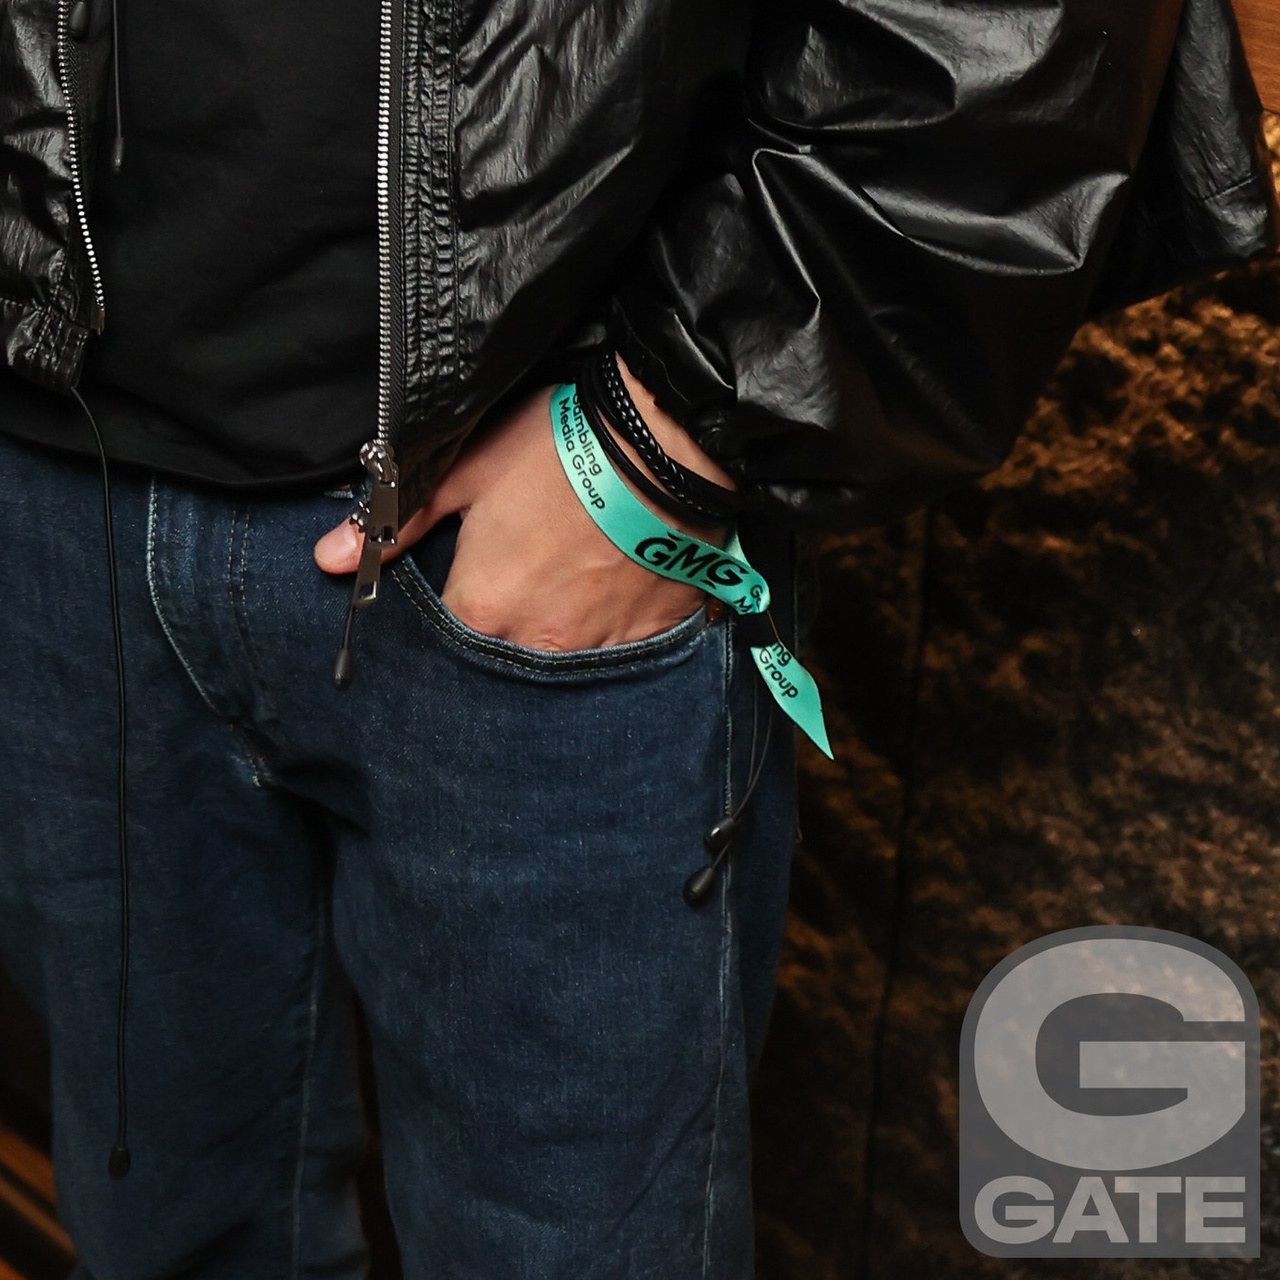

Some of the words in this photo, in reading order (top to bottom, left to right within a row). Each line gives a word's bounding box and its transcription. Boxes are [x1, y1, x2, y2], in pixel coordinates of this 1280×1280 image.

[558, 396, 576, 453] Media
[572, 454, 606, 511] Group
[760, 647, 798, 698] Group
